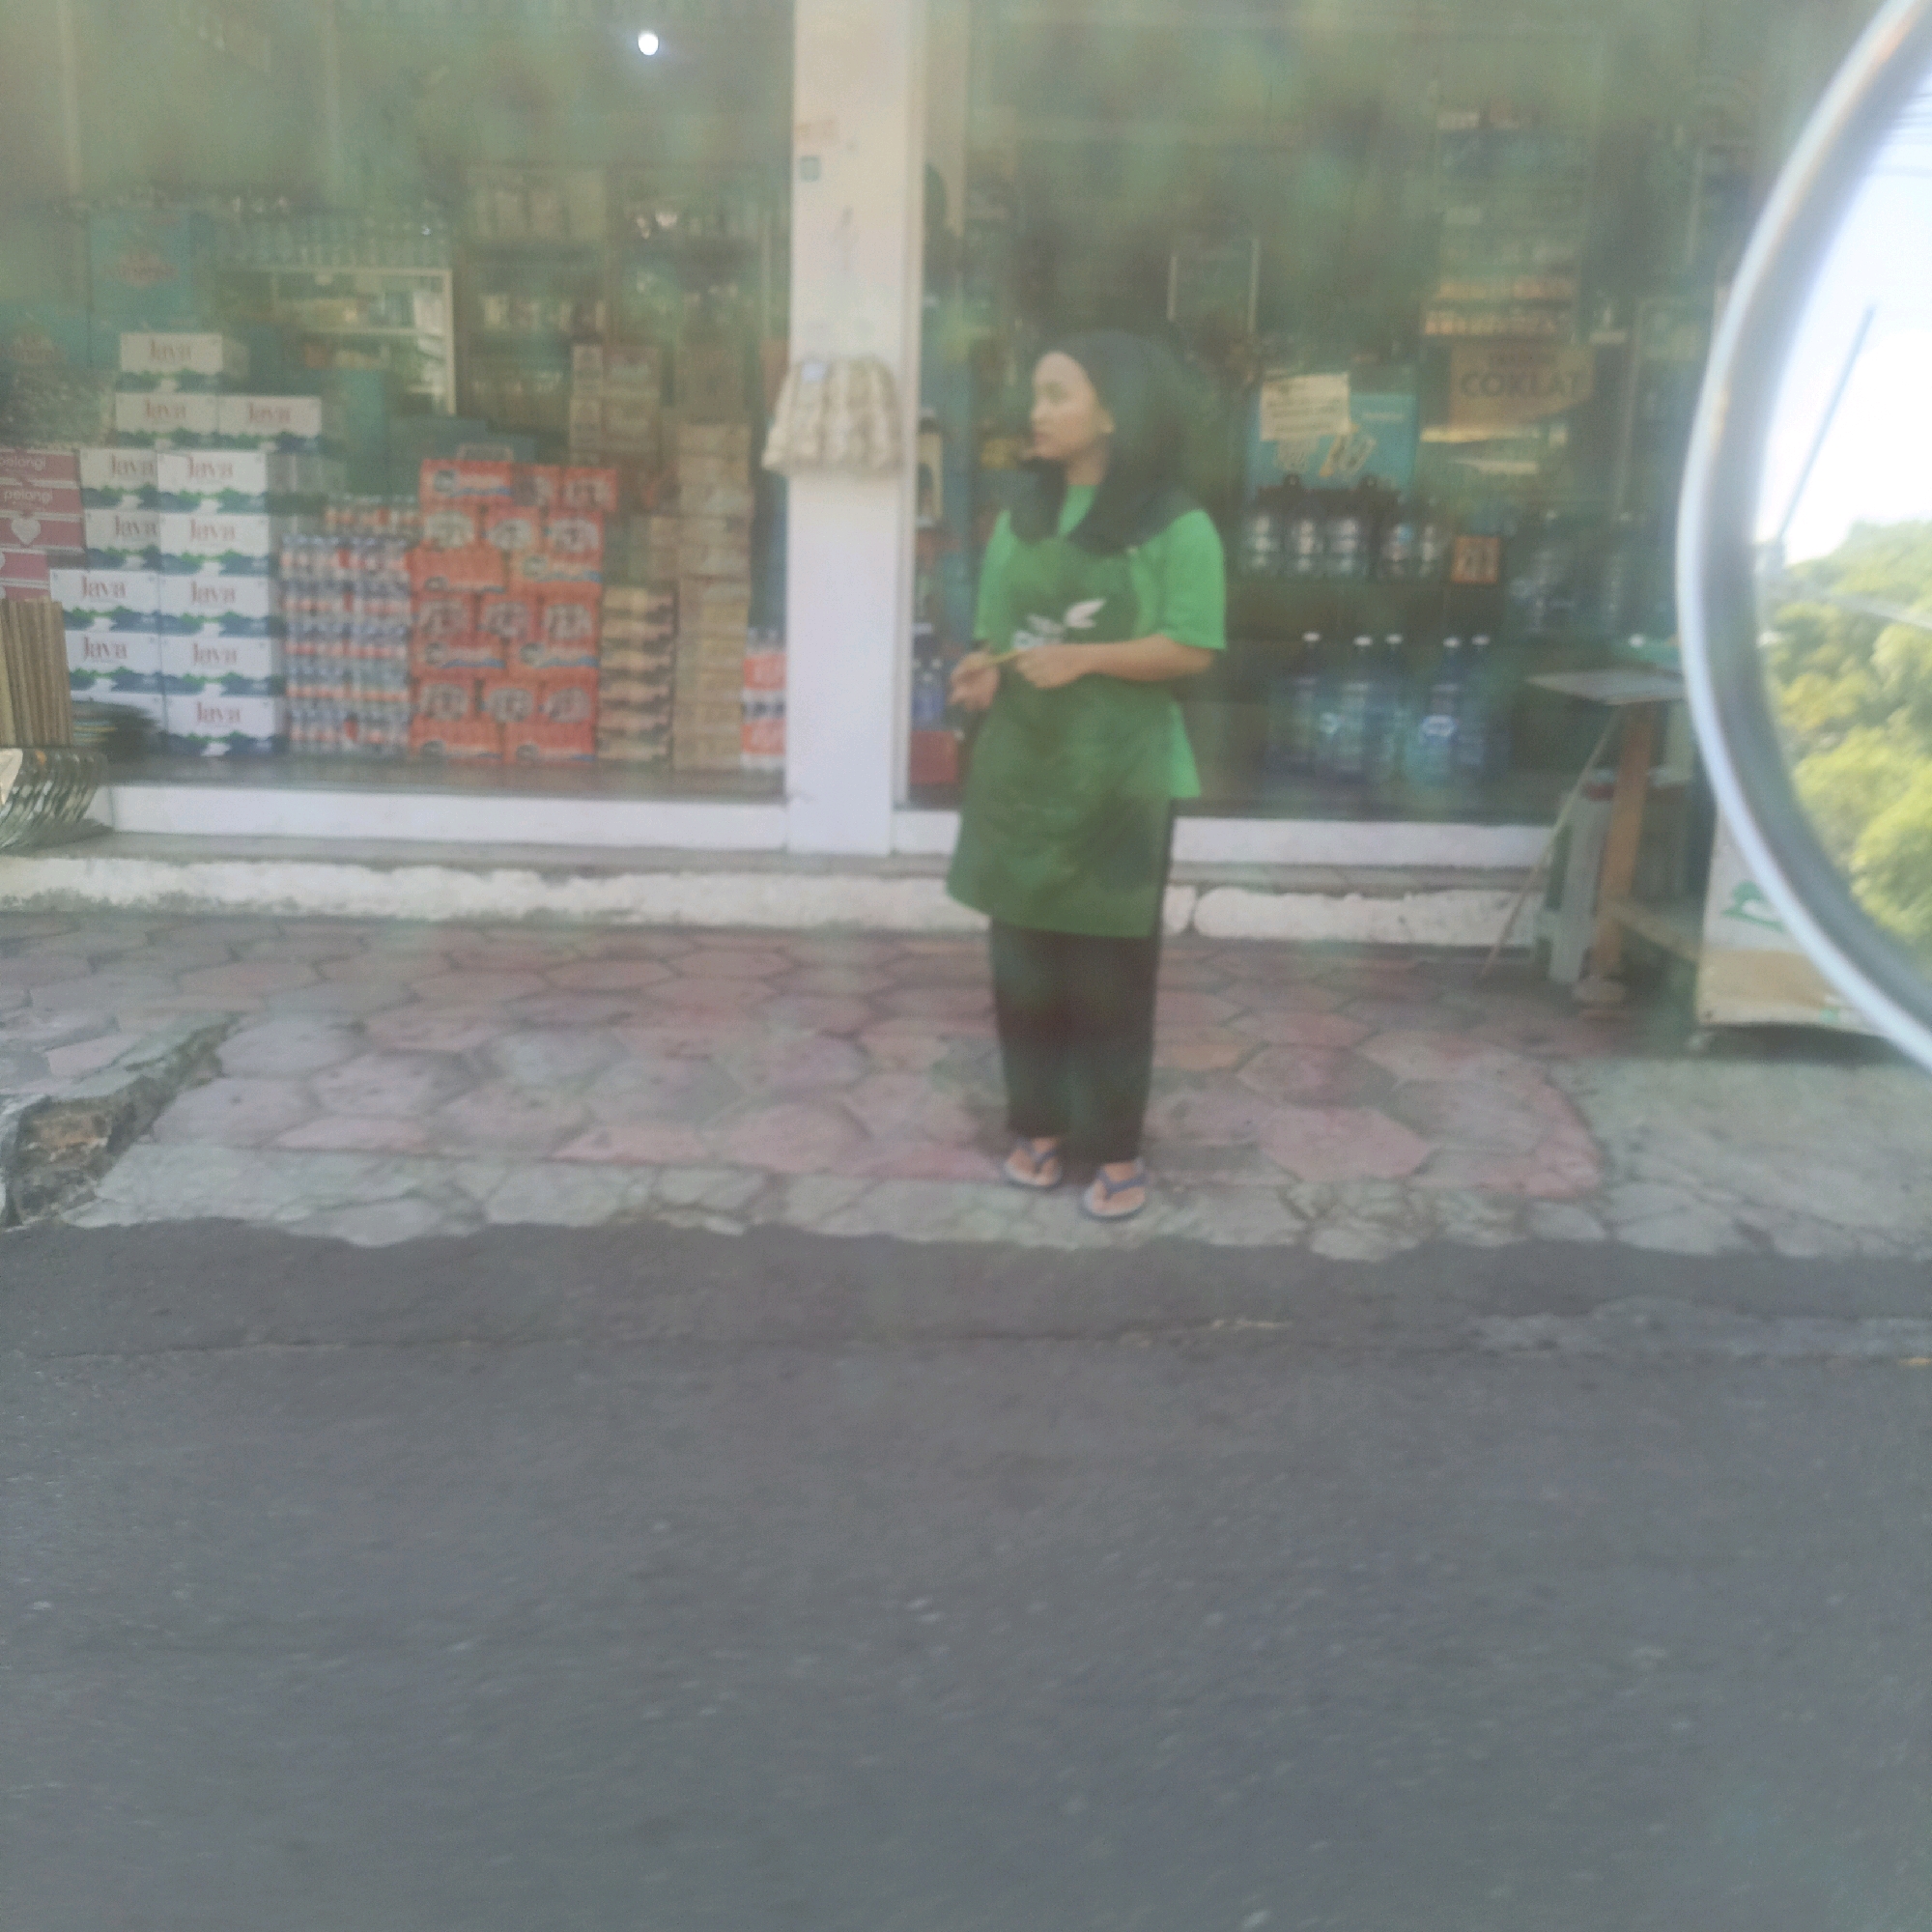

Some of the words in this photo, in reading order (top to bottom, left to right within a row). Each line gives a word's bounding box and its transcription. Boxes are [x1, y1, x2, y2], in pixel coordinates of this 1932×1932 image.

[187, 455, 234, 479] Java
[189, 518, 237, 541] Java
[81, 575, 127, 599] Java
[191, 580, 237, 605] Java
[83, 636, 128, 661] Java
[193, 642, 238, 667] Java
[196, 701, 242, 724] Java
